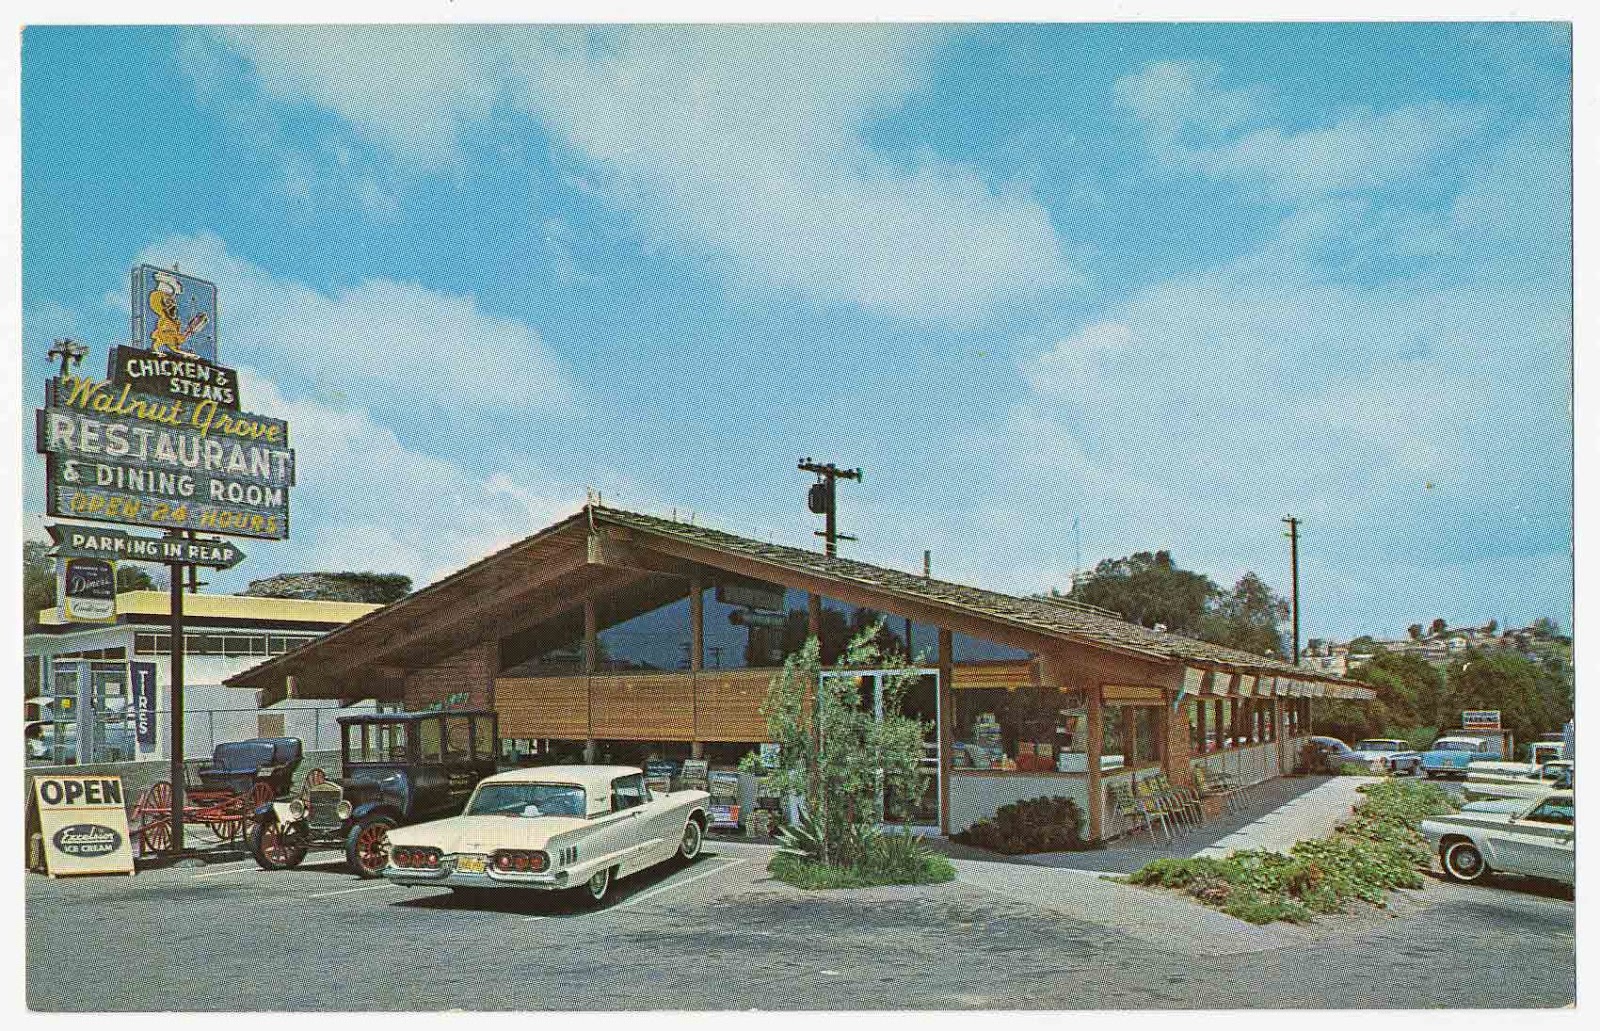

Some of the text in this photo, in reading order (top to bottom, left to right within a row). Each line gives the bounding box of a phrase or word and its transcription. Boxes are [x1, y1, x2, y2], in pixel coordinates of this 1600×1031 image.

[127, 358, 228, 386] CHICKEN &
[169, 377, 235, 404] STEAKS
[62, 376, 281, 442] Walnut Grove
[49, 412, 290, 481] RESTAURANT
[63, 460, 283, 508] & DINING ROOM
[70, 490, 278, 534] OPEN 24 HOURS
[72, 533, 234, 561] PARKING IN REAR
[138, 670, 149, 735] TIRES
[41, 779, 122, 804] OPEN
